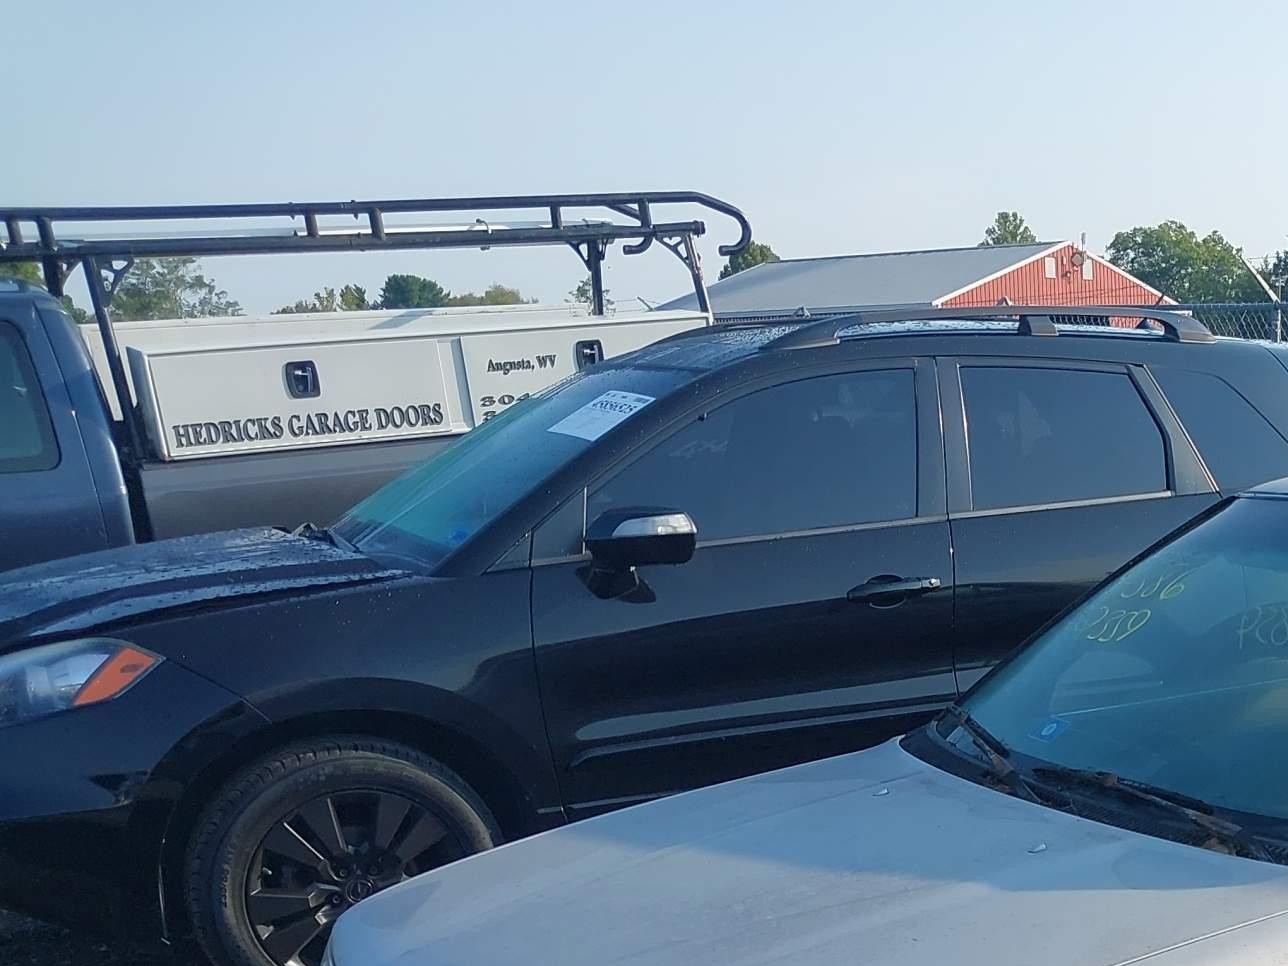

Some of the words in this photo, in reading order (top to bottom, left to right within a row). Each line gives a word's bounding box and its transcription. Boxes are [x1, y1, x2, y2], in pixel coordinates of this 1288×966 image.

[536, 354, 557, 368] WV
[171, 415, 284, 449] HEDRICKS
[287, 408, 372, 438] GARAGE
[374, 402, 444, 431] DOORS
